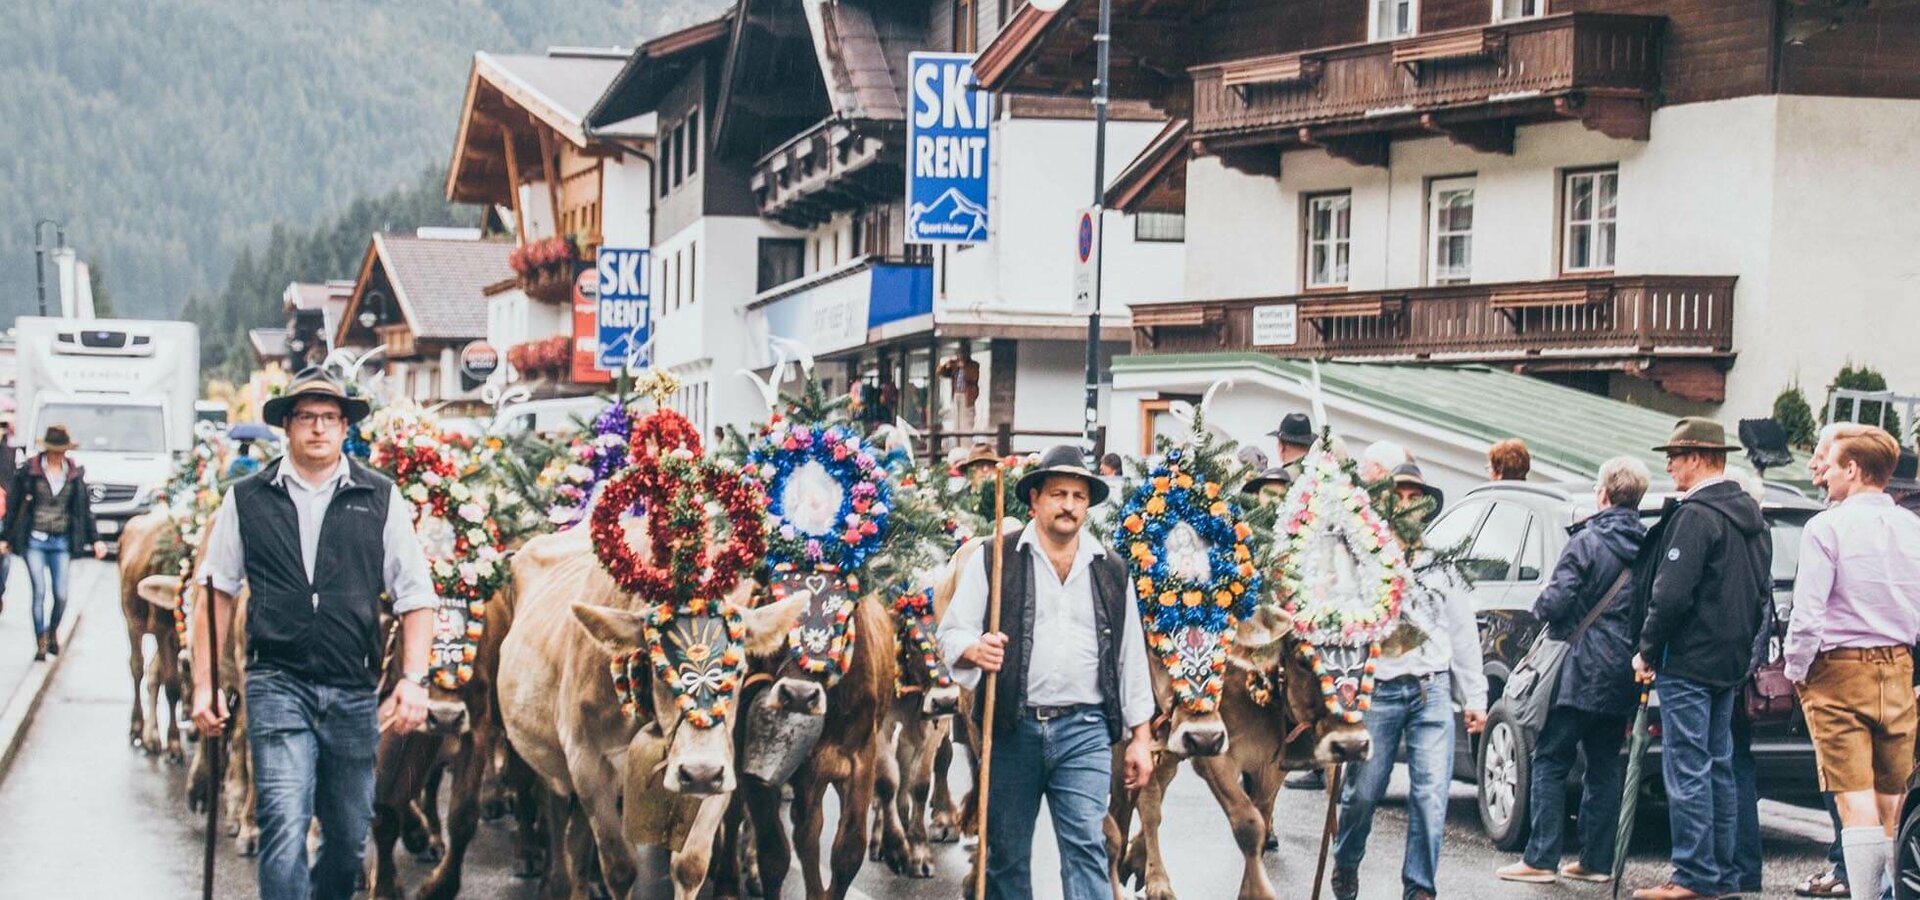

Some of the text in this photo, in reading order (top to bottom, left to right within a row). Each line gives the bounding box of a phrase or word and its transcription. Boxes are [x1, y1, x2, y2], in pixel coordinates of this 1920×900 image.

[915, 63, 988, 129] SKI
[916, 135, 986, 179] RENT
[919, 222, 941, 234] Sport
[600, 251, 649, 296] SKI
[601, 298, 648, 328] RENT
